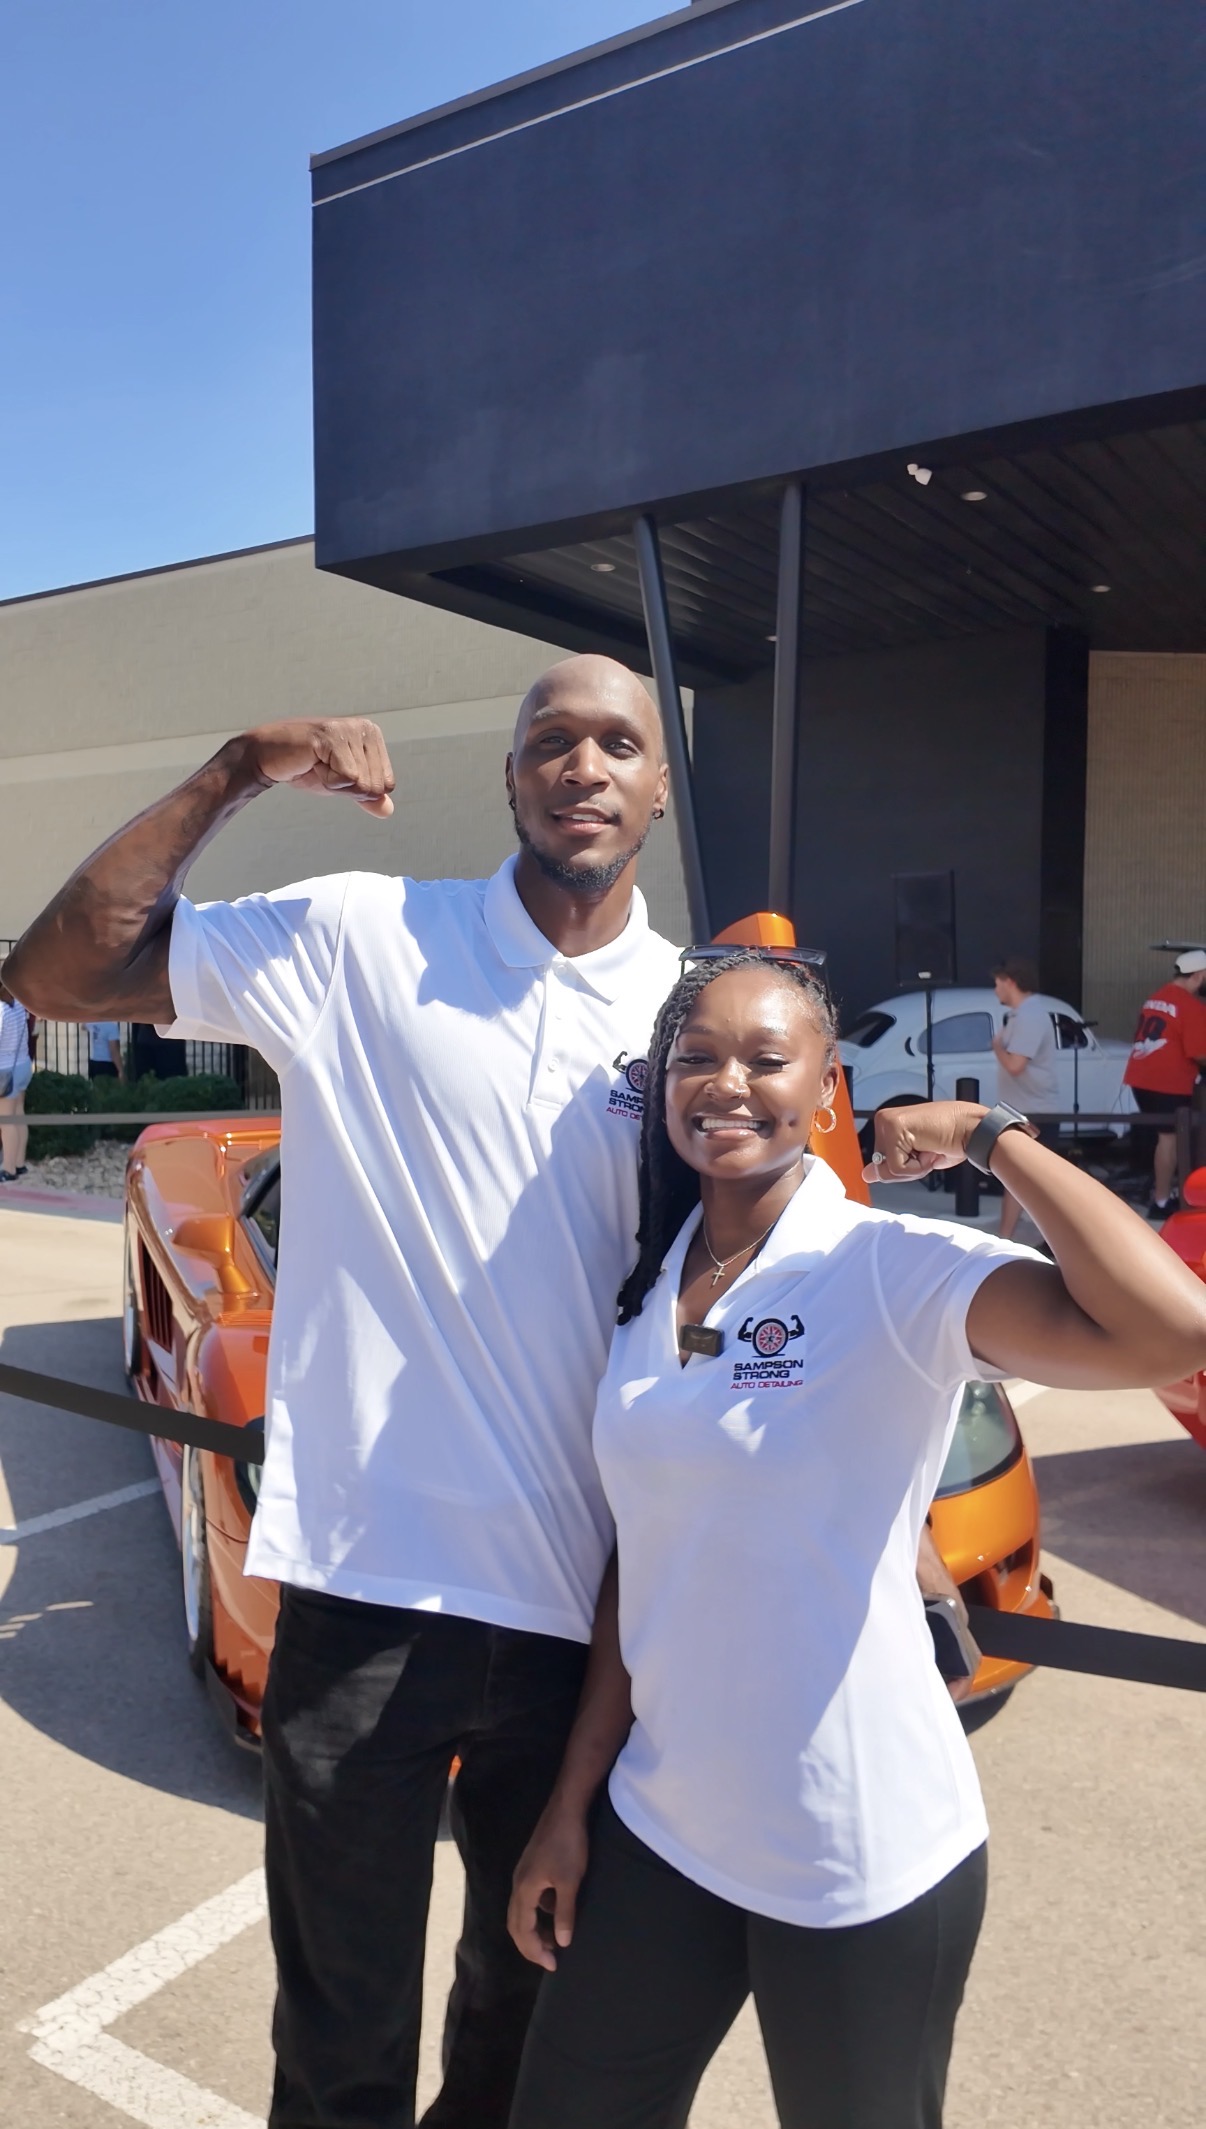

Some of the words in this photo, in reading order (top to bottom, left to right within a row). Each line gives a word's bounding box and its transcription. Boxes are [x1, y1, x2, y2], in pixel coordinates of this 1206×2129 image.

[610, 1090, 643, 1103] SAMP
[609, 1098, 643, 1112] STRO
[606, 1107, 627, 1116] AUTO
[734, 1359, 803, 1370] SAMPSON
[733, 1370, 789, 1380] STRONG
[758, 1380, 803, 1388] DETAILING
